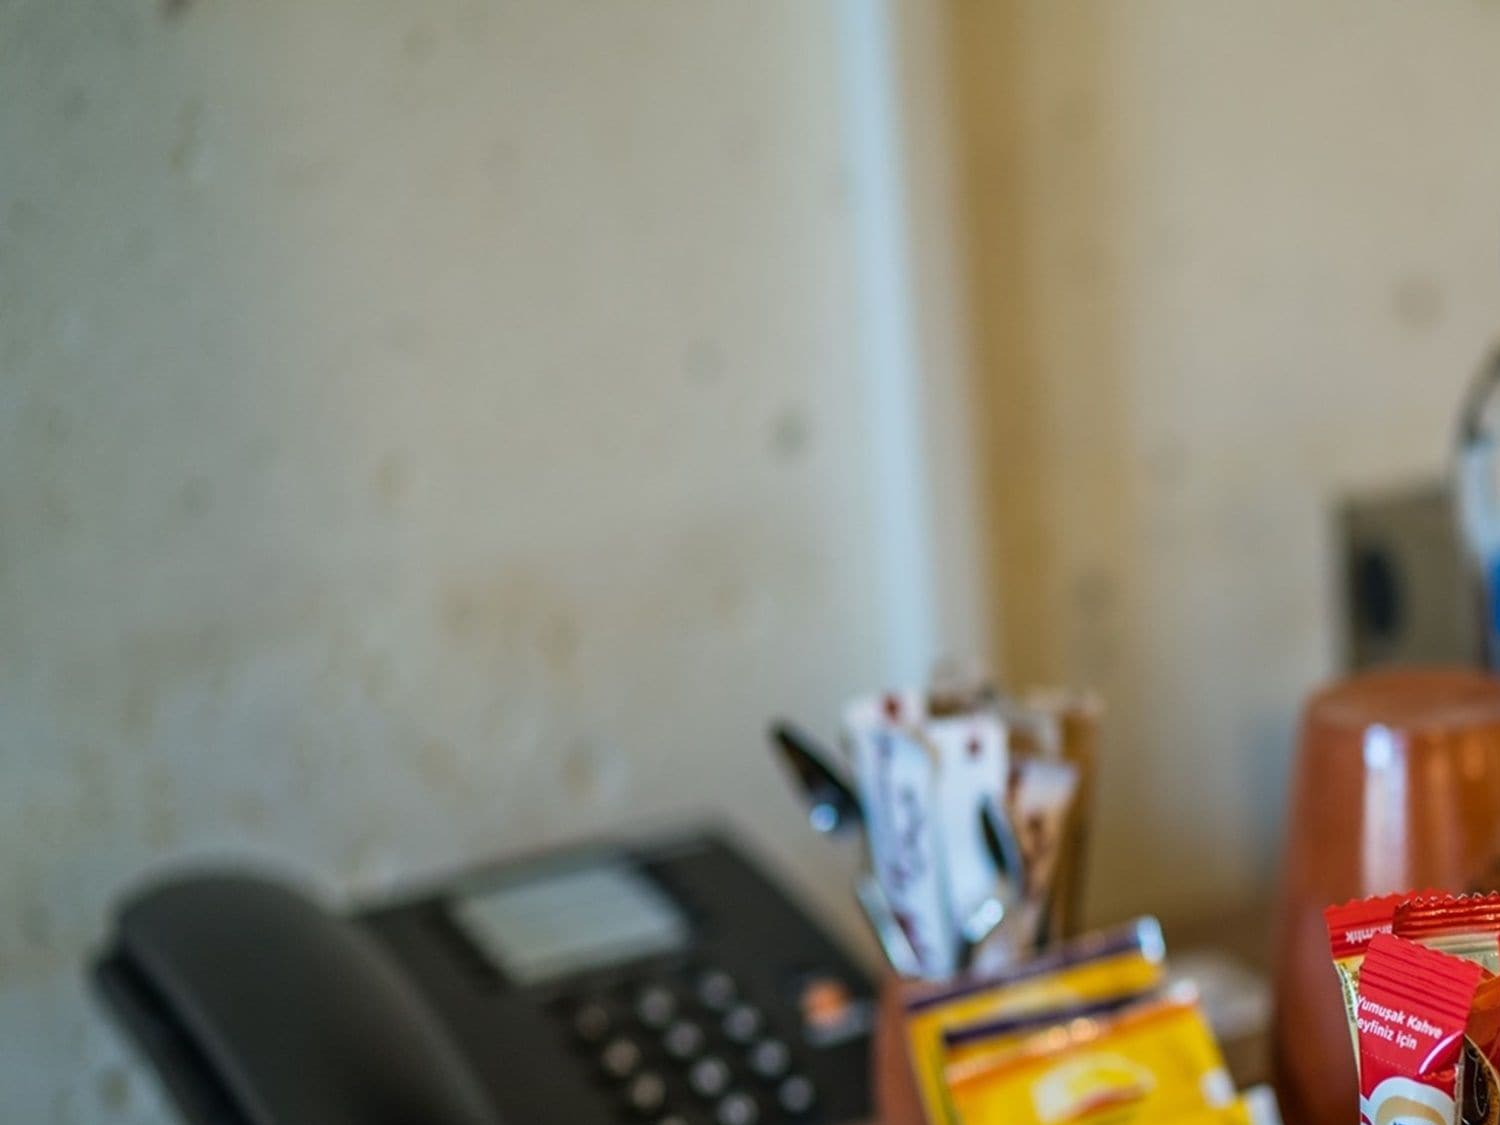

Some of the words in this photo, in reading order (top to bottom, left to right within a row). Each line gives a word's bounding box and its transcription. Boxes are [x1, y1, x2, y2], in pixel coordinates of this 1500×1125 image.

[1357, 1018, 1394, 1041] eyfiniz
[1358, 995, 1405, 1024] Yumuşak
[1407, 1015, 1443, 1039] Kahve
